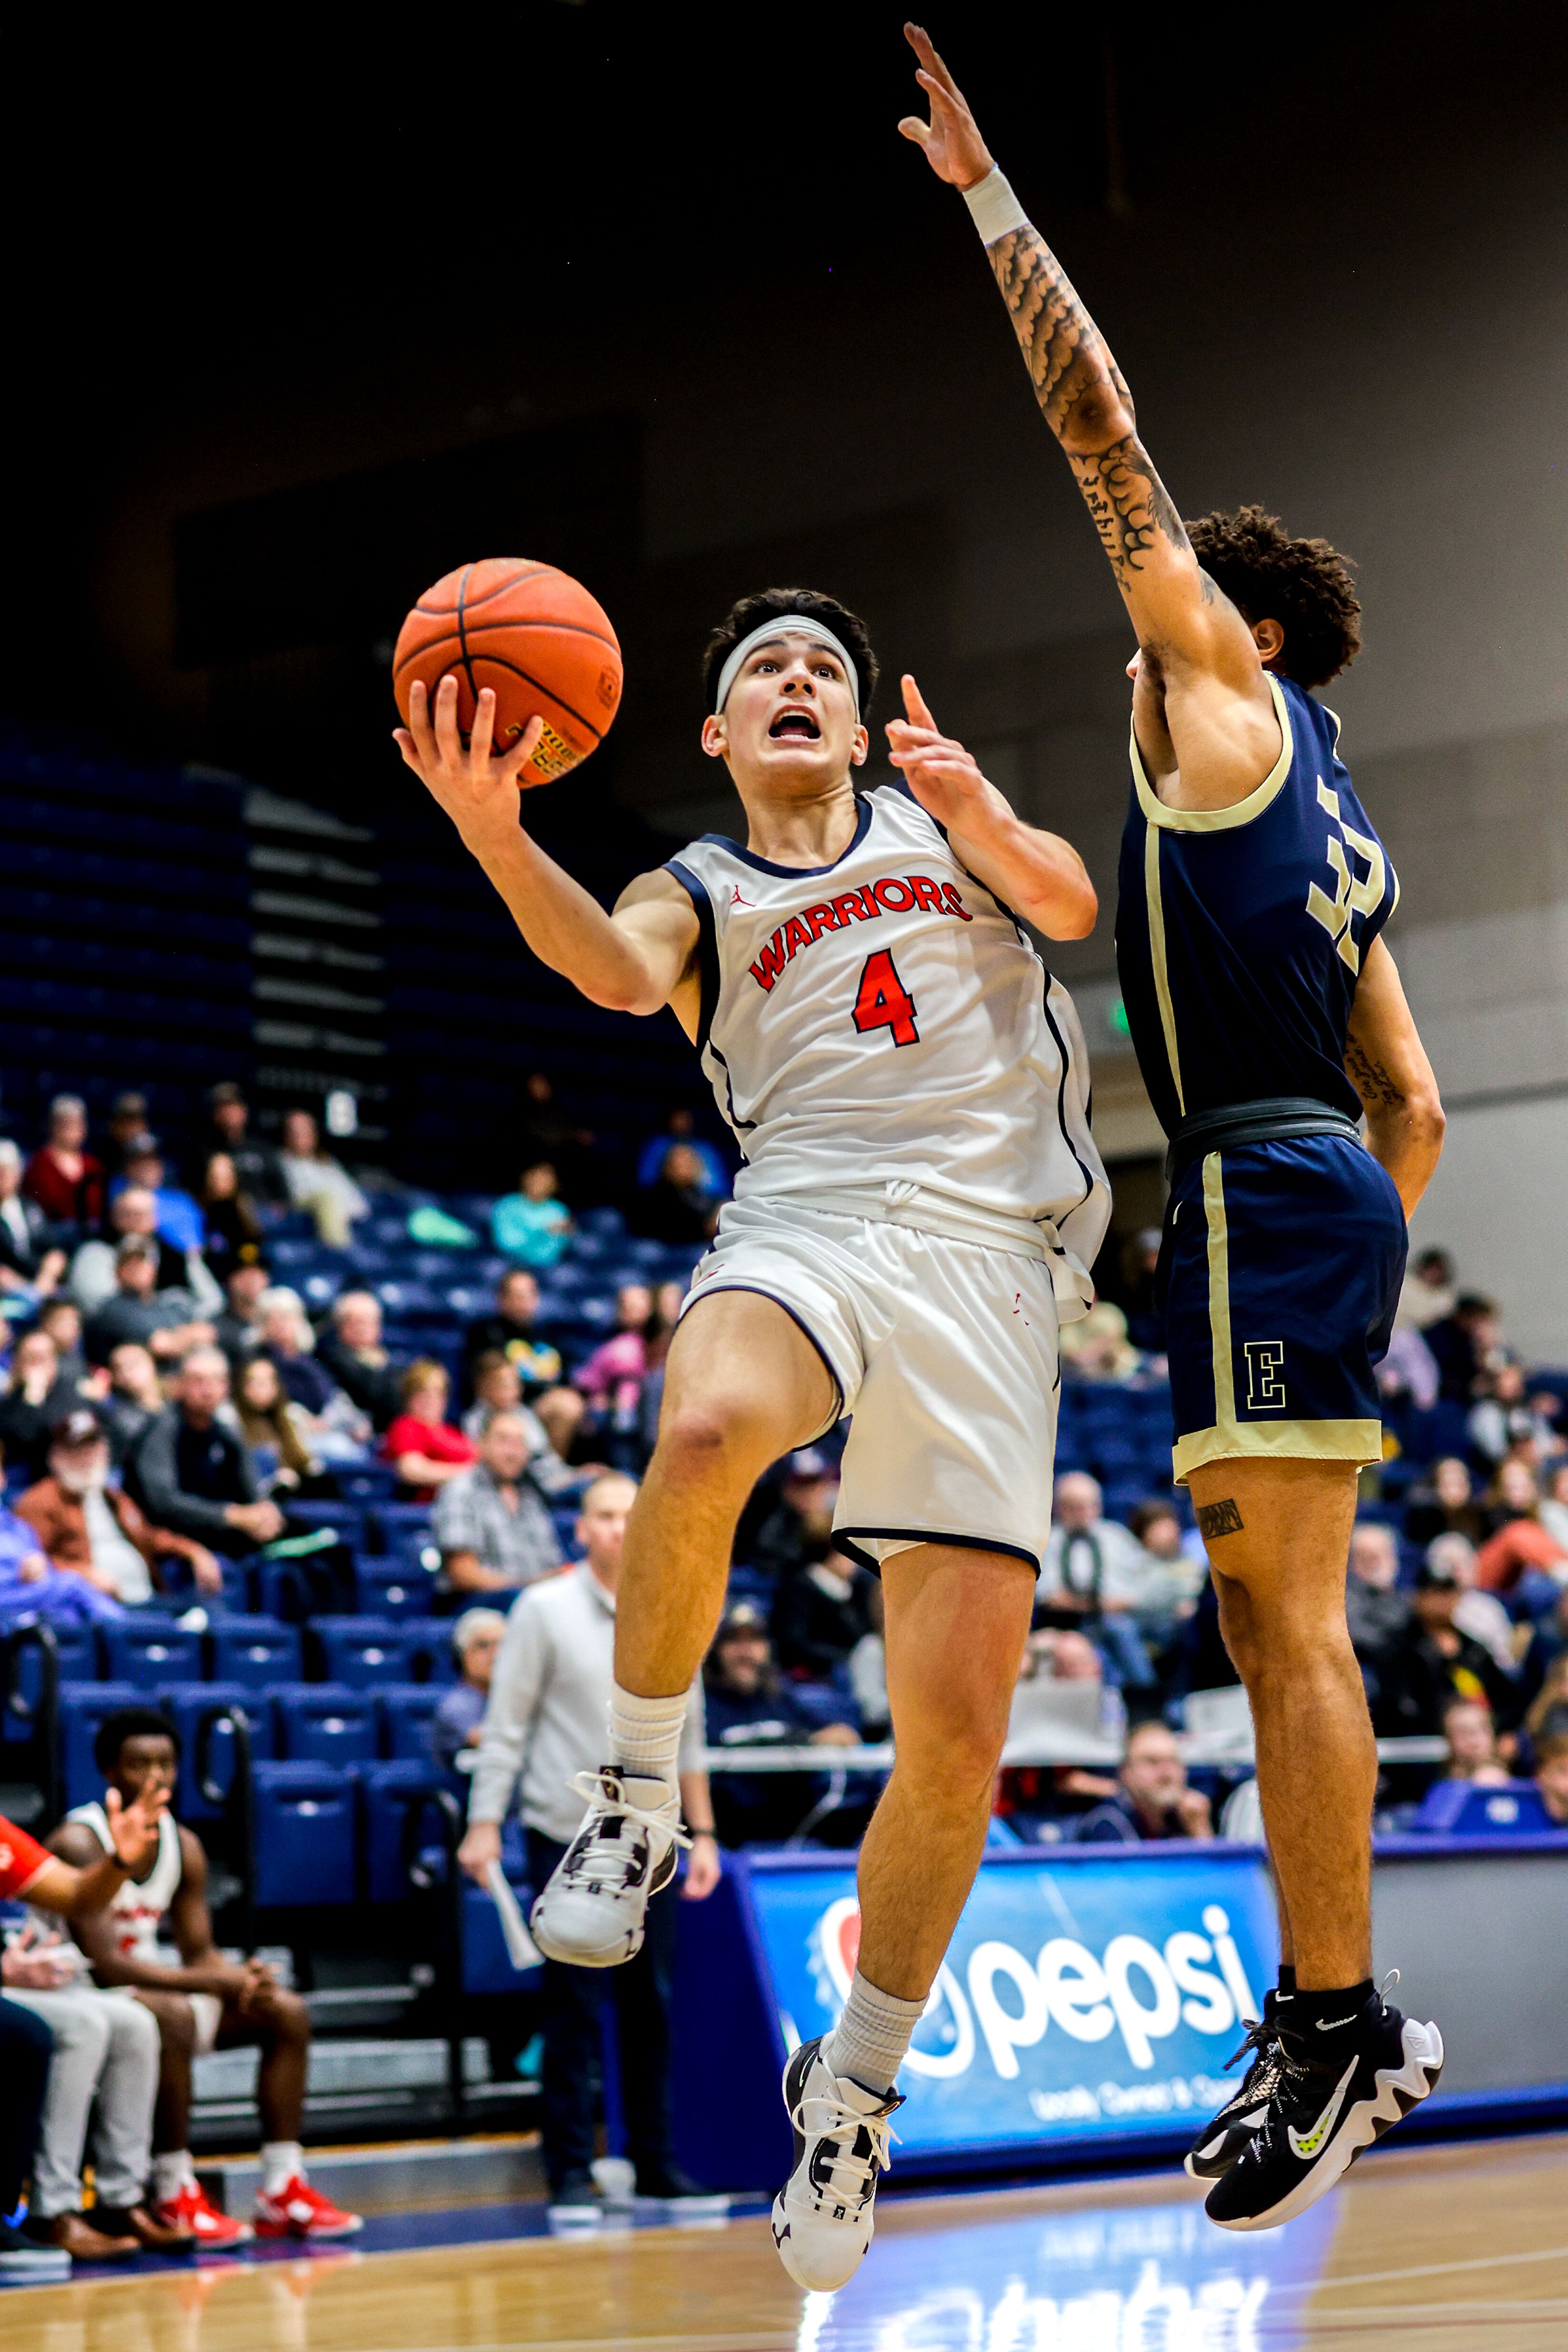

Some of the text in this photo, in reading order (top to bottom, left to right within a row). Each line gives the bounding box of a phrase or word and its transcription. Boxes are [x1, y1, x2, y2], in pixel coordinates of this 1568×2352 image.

[748, 875, 973, 993] WARRIORS
[851, 947, 920, 1049] 4
[1244, 1341, 1285, 1409] E
[967, 1904, 1262, 2079] pepsi
